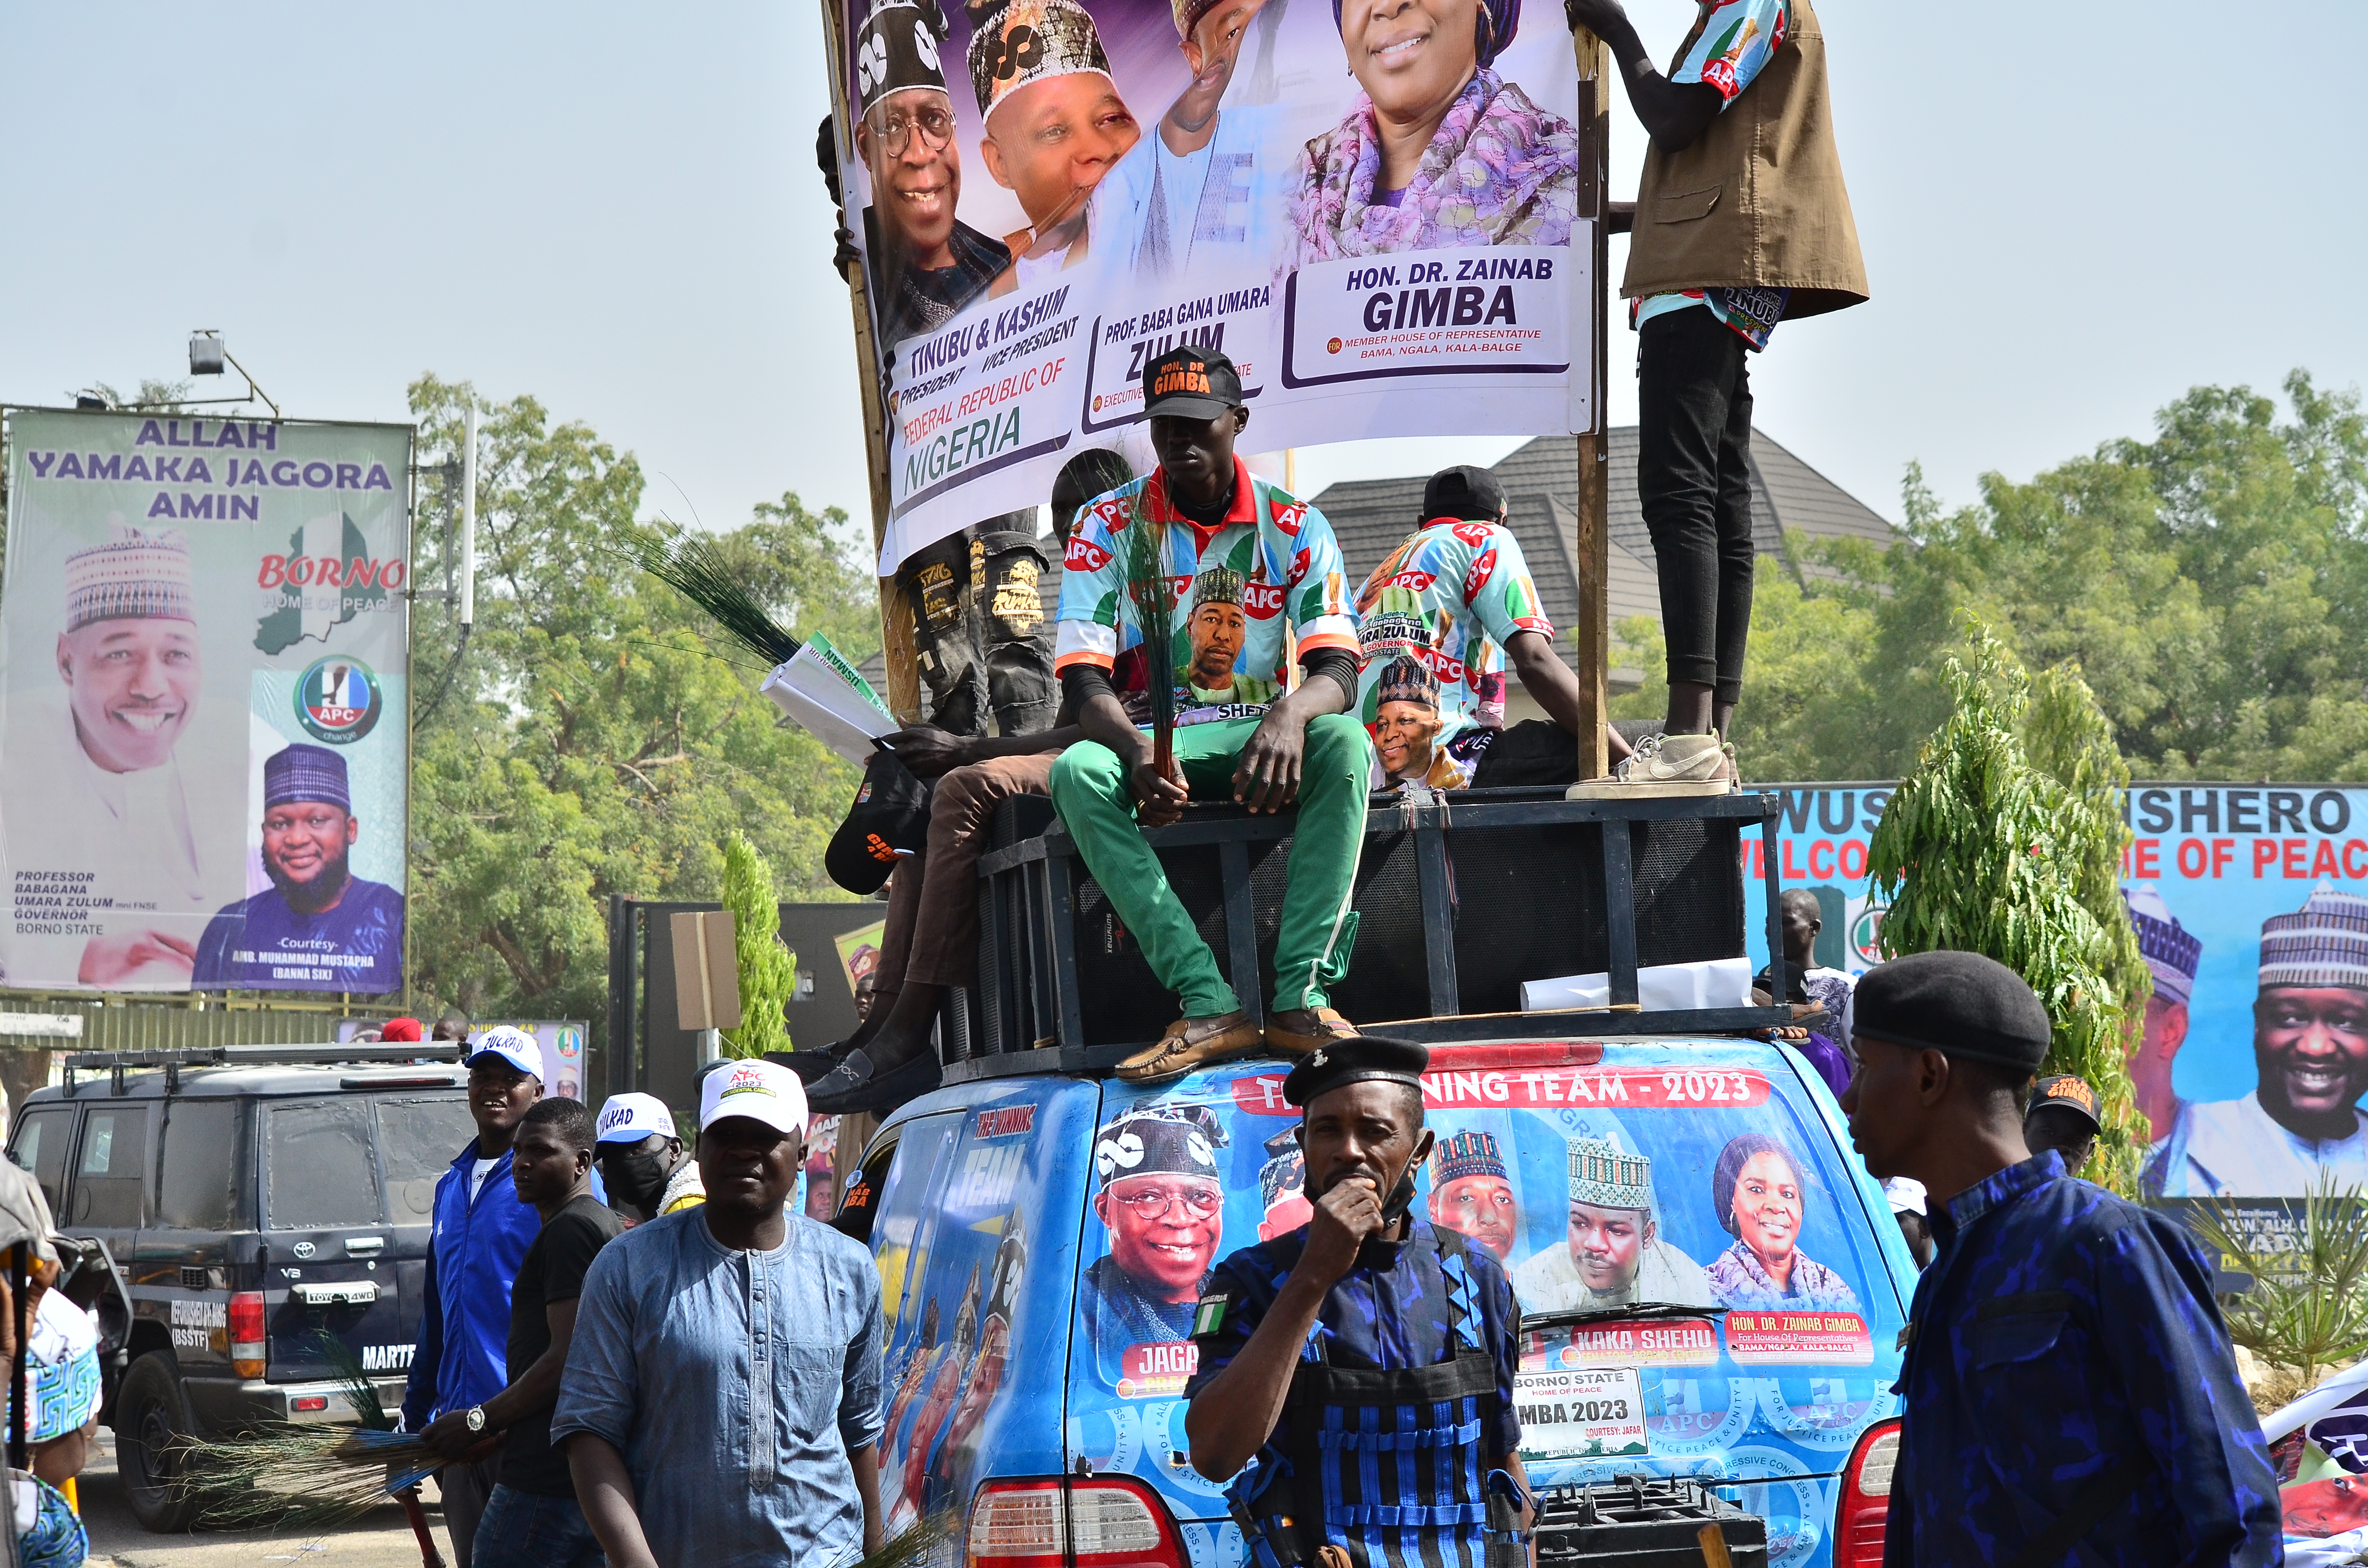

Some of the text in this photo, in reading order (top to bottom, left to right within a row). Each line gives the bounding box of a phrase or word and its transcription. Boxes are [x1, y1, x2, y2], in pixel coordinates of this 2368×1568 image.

[1346, 258, 1554, 291] HON. DR. ZAINAB
[1105, 286, 1270, 345] PROF. BABA GANA UMARA
[1363, 285, 1517, 332] GIMBA
[911, 284, 1070, 379] TINUBU & KASHIM
[1328, 330, 1541, 351] FOR MEMBER HOUSE OF REPRESENTATIVE
[981, 316, 1080, 373] VICE PRESIDENT
[1360, 343, 1522, 359] BAMA, NGALA, KALA-BALGE
[1161, 361, 1205, 372] HON. DR
[900, 366, 966, 409] PRESIDENT
[1155, 372, 1211, 395] GIMBA
[904, 357, 1065, 449] FEDERAL REPUBLIC OF
[1104, 387, 1143, 408] EXECUTIVE
[135, 420, 277, 450] ALLAH
[904, 406, 1020, 496] NIGERIA
[28, 452, 393, 490] YAMAKA JAGORA
[148, 492, 259, 520] AMIN
[1064, 541, 1100, 567] APC
[258, 554, 406, 589] BORNO
[1391, 575, 1424, 590] APC
[263, 594, 398, 612] HOME OF PEACE
[1245, 587, 1282, 609] APC
[1373, 618, 1421, 627] Babagana
[1374, 611, 1408, 619] Excellency
[1383, 626, 1431, 644] ZULUM
[1362, 651, 1378, 660] ORNO
[1367, 640, 1413, 651] GOVERNOR
[824, 649, 860, 686] USMAN
[1424, 652, 1462, 678] APC
[319, 708, 355, 721] APC
[323, 732, 357, 741] change
[2177, 838, 2235, 879] OF
[15, 871, 95, 882] PROFESSOR
[14, 884, 87, 894] BABAGANA
[14, 896, 62, 906] UMARA
[66, 897, 113, 907] ZULUM
[14, 909, 88, 920] GOVERNOR
[16, 923, 103, 935] BORNO STATE
[233, 951, 374, 968] AMB. MUHAMMAD MUSTAPHA
[483, 1035, 523, 1053] ZULKAD
[730, 1073, 766, 1083] APC
[1520, 1072, 1629, 1102] TEAM
[1663, 1072, 1751, 1102] 2023
[721, 1087, 753, 1098] PRESIDENTIAL
[2047, 1088, 2092, 1112] GIMBA
[2050, 1082, 2093, 1102] ZAINAB
[974, 1103, 1038, 1140] THE WINNING
[957, 1144, 1025, 1207] TEAM
[351, 1292, 373, 1300] 4WD
[1732, 1317, 1861, 1332] HON. DR. ZAINAB GIMBA
[172, 1328, 209, 1351] (BSSTF)
[1578, 1330, 1711, 1350] KAKA SHEHU
[1794, 1334, 1858, 1343] Representatives
[1634, 1350, 1668, 1360] BORNO
[1786, 1352, 1840, 1360] Constituency
[1515, 1372, 1625, 1387] BORNO STATE
[1572, 1399, 1628, 1422] 2023
[1772, 1390, 1783, 1413] FOR
[1782, 1415, 1826, 1442] JUSTICE
[1874, 1379, 1885, 1415] UNITY
[1808, 1402, 1857, 1422] APC
[1622, 1425, 1641, 1434] JAFAR
[1660, 1413, 1713, 1433] APC
[1687, 1436, 1721, 1453] PEACE
[1728, 1390, 1741, 1426] UNITY
[1174, 1466, 1217, 1488] USTICE
